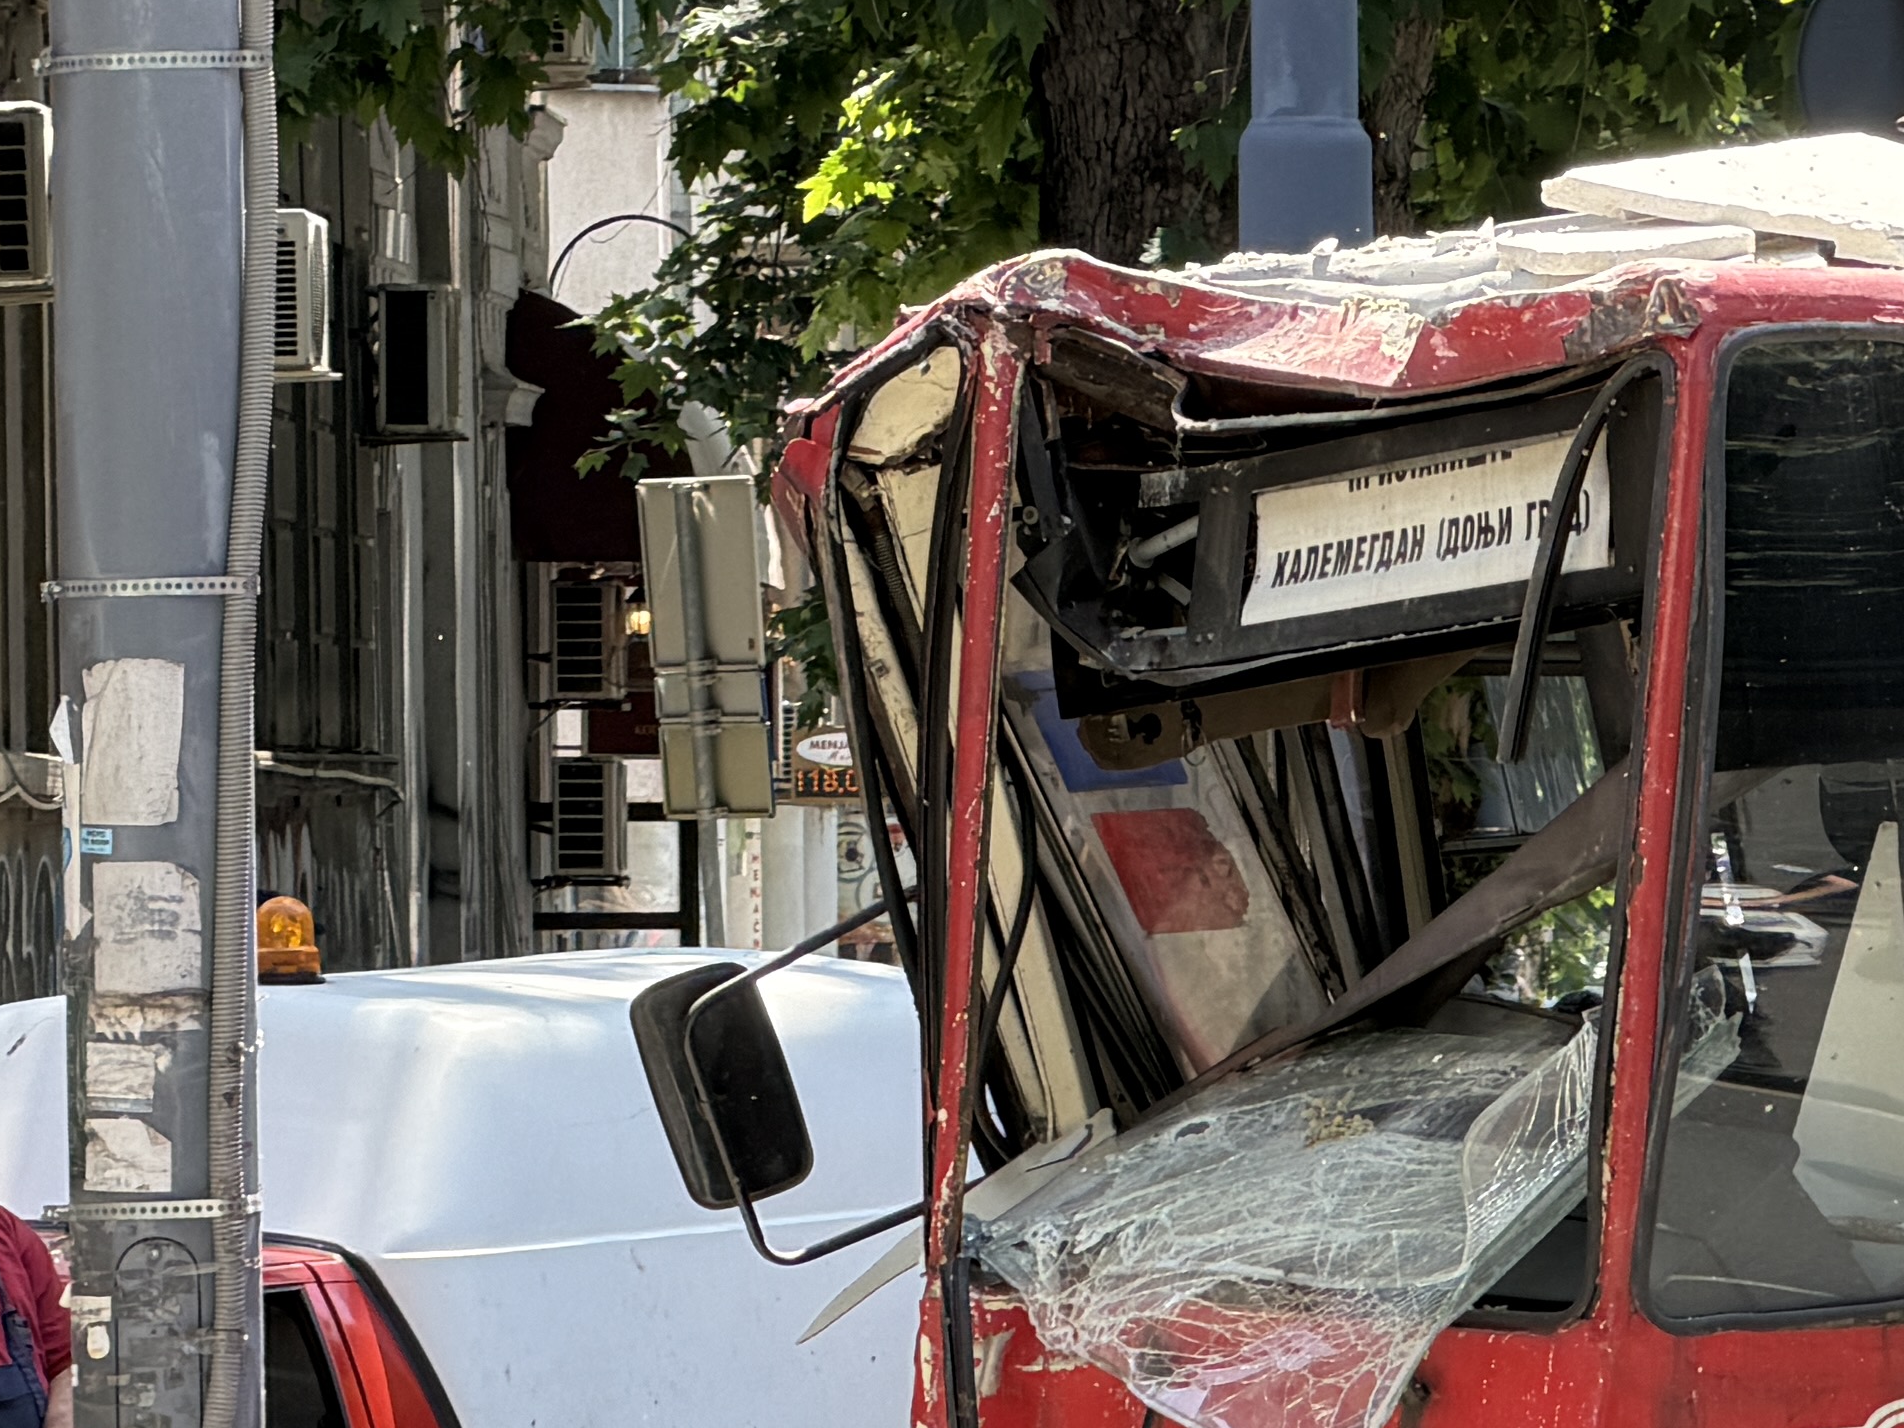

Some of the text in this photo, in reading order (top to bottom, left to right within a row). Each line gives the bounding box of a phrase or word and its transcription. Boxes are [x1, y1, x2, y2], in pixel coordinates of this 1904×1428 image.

[1270, 488, 1591, 589] КАЛЕМЕГДАН (ДОЊИ ГРД)
